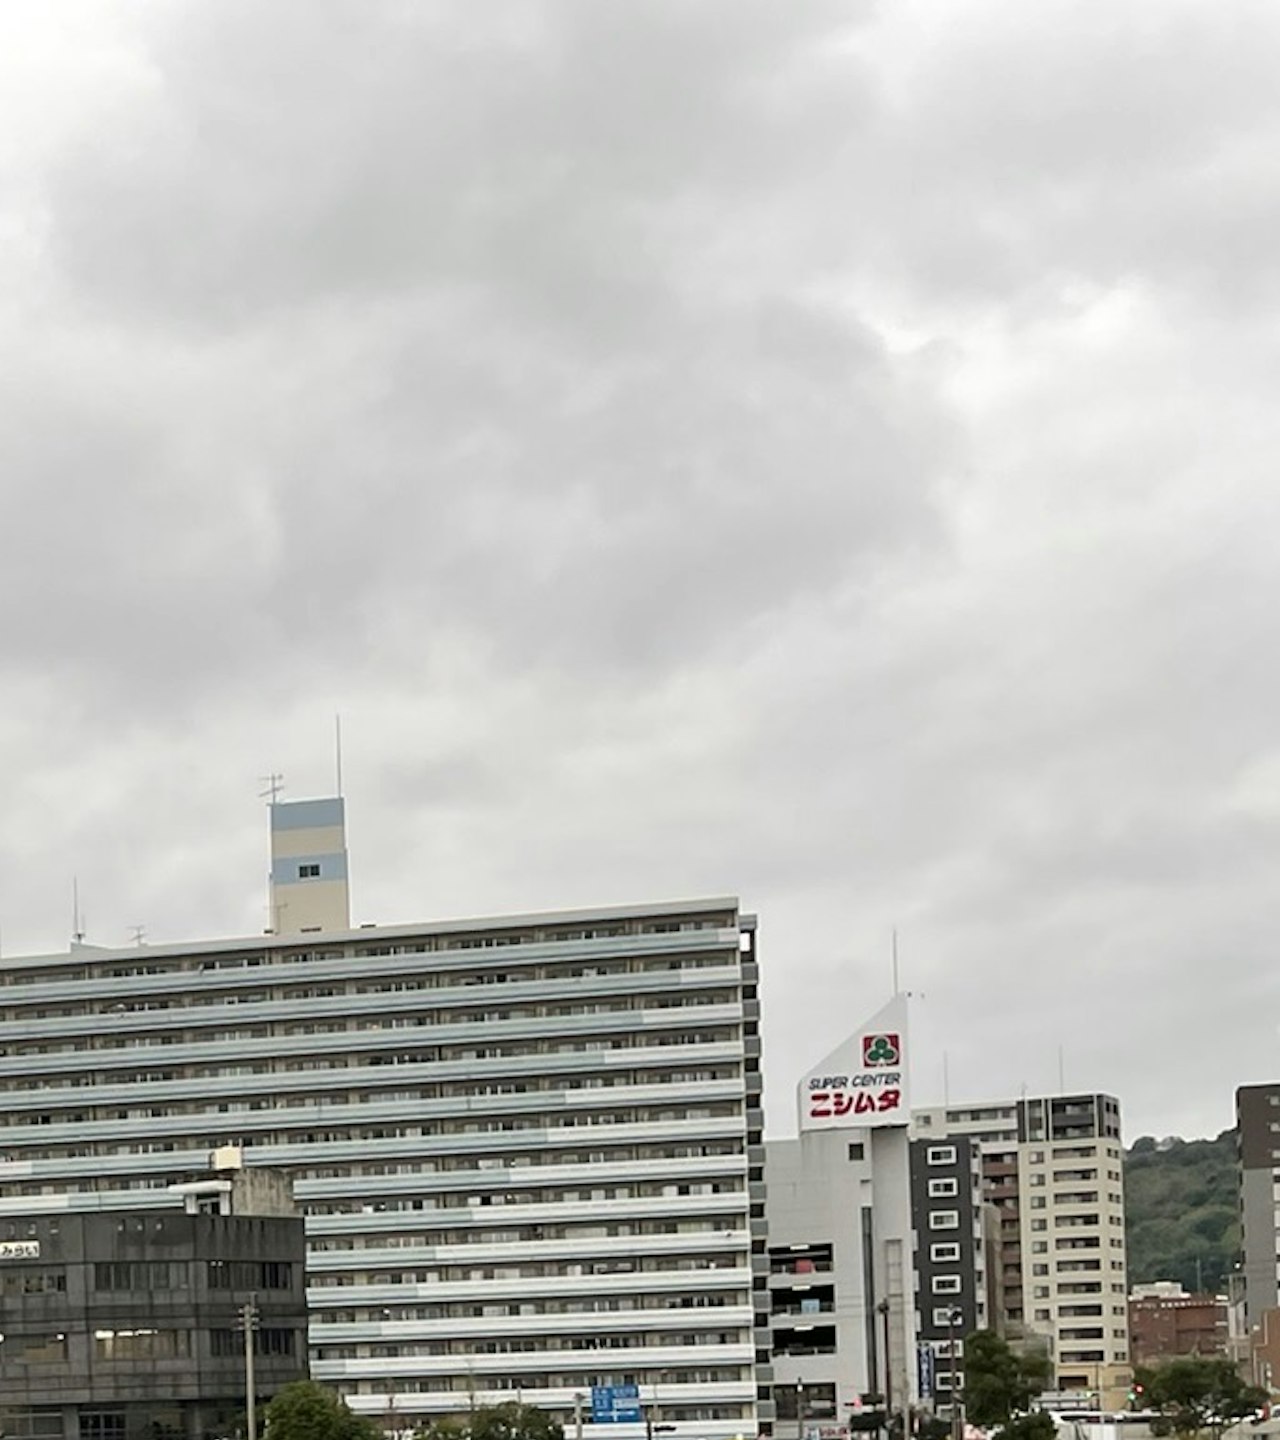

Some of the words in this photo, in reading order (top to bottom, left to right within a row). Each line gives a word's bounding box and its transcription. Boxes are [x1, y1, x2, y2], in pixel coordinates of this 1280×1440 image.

[809, 1076, 848, 1090] SUPER
[852, 1073, 900, 1087] CENTER
[810, 1090, 900, 1117] ニシムタ
